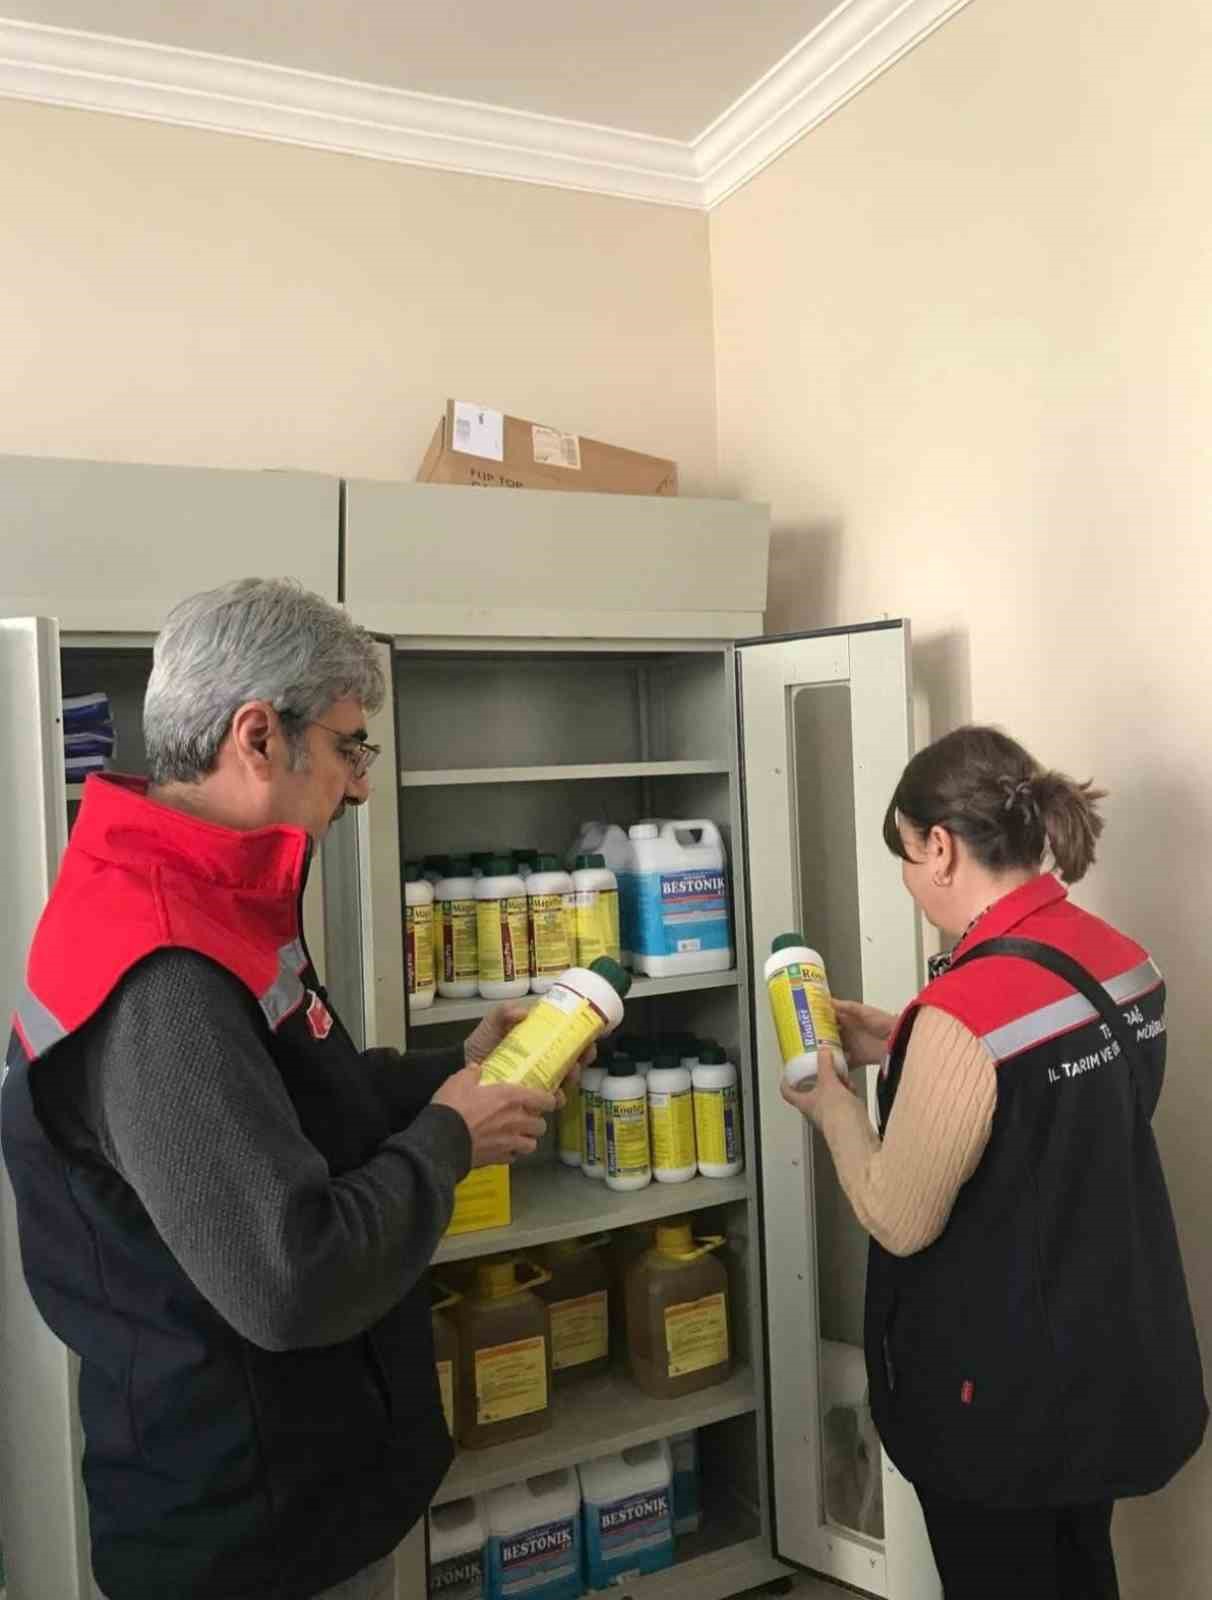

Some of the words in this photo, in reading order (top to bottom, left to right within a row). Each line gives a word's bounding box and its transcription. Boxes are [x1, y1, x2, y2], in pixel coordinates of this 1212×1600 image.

[1061, 1051, 1101, 1078] TARIM
[601, 1494, 669, 1527] BESTONIK
[503, 1526, 572, 1561] BESTONIK
